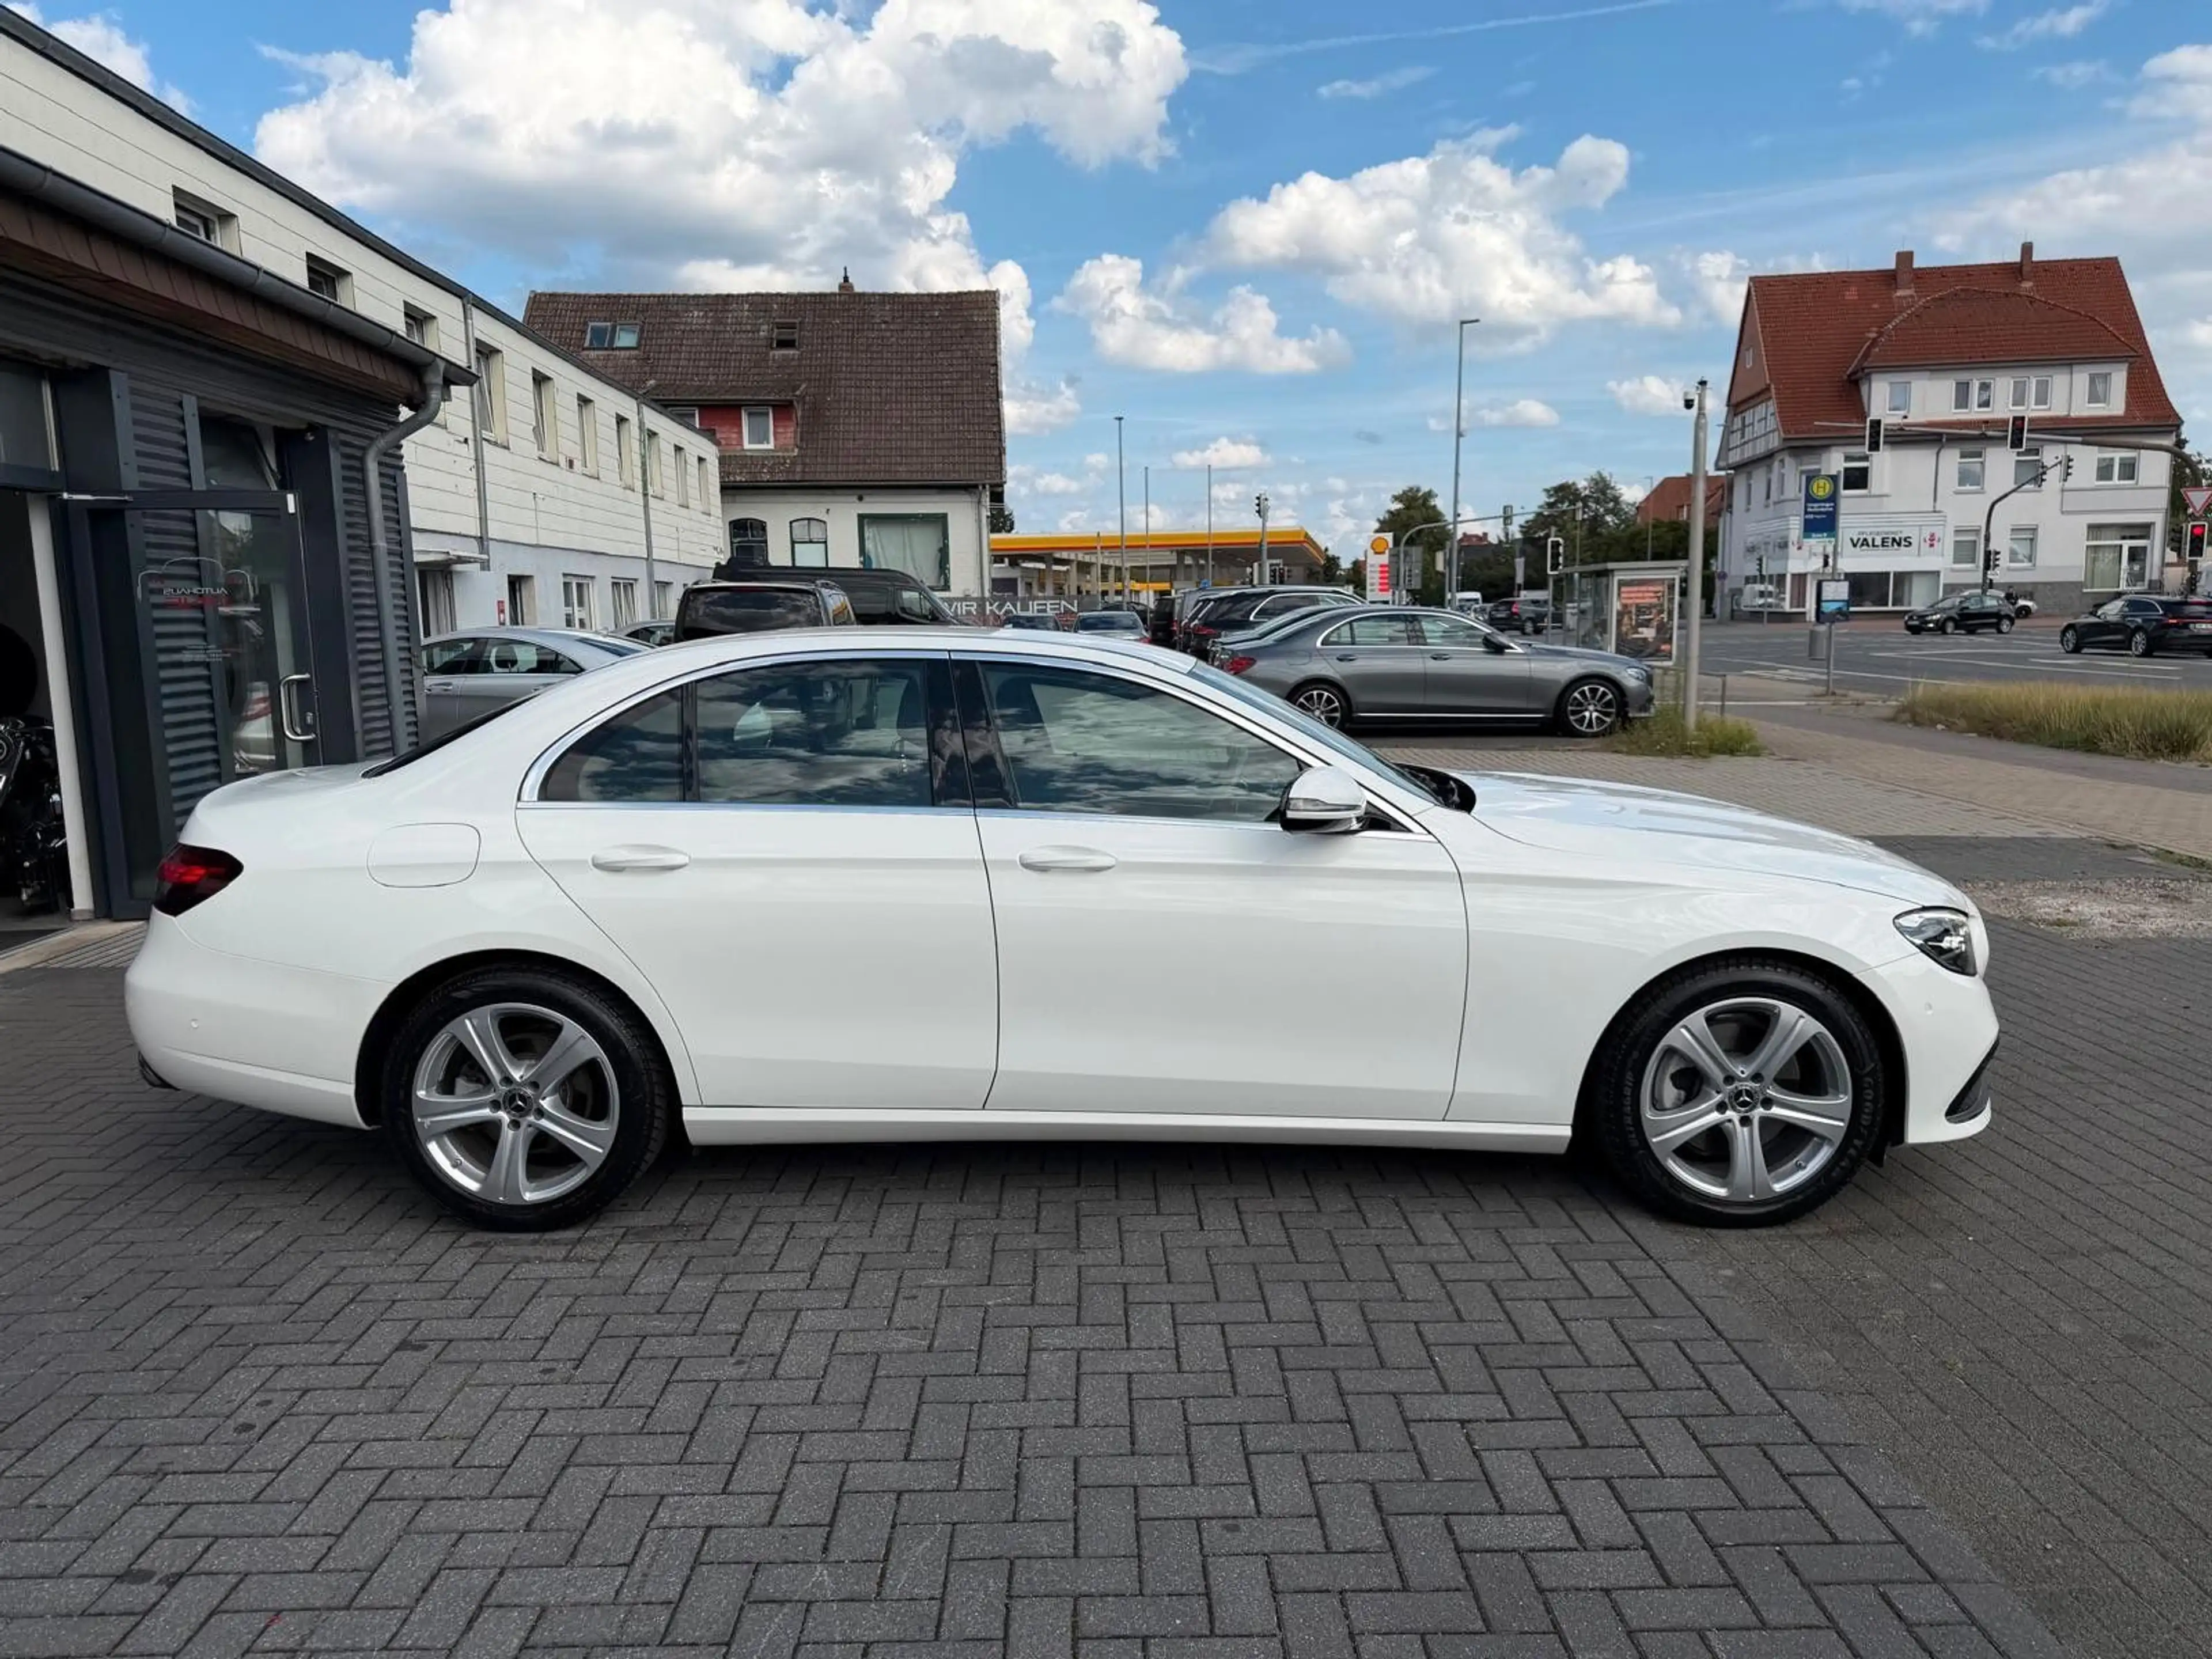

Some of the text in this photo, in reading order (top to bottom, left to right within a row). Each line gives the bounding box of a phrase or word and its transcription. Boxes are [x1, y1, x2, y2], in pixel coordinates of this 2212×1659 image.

[1816, 482, 1826, 494] H
[1850, 536, 1912, 548] VALENS
[987, 600, 1078, 615] KAUFEN
